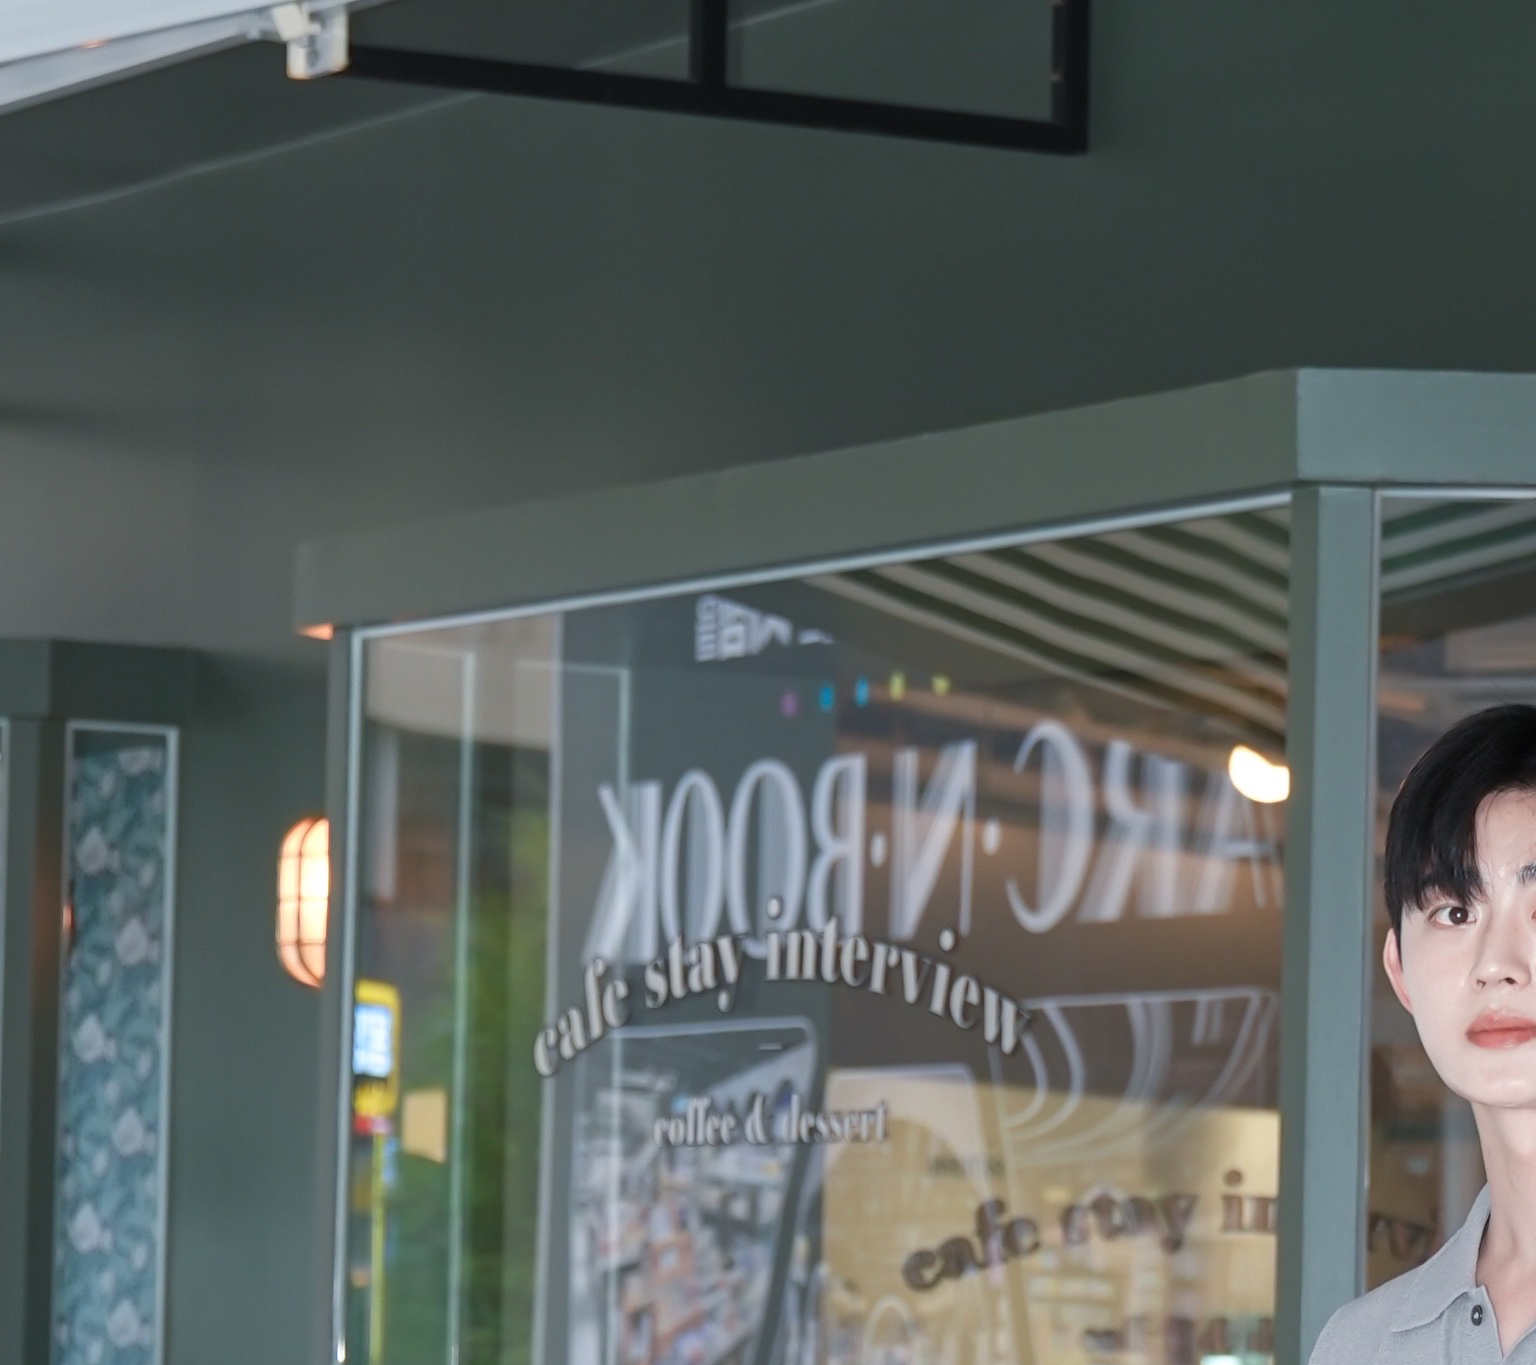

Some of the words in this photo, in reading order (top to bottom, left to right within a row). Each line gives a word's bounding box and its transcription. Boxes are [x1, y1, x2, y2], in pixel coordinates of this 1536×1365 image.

[533, 956, 631, 1077] cafe
[644, 932, 745, 1013] stay
[765, 896, 1033, 1055] interview
[653, 1095, 737, 1148] coffee
[744, 1093, 769, 1145] &
[783, 1093, 889, 1145] dessert
